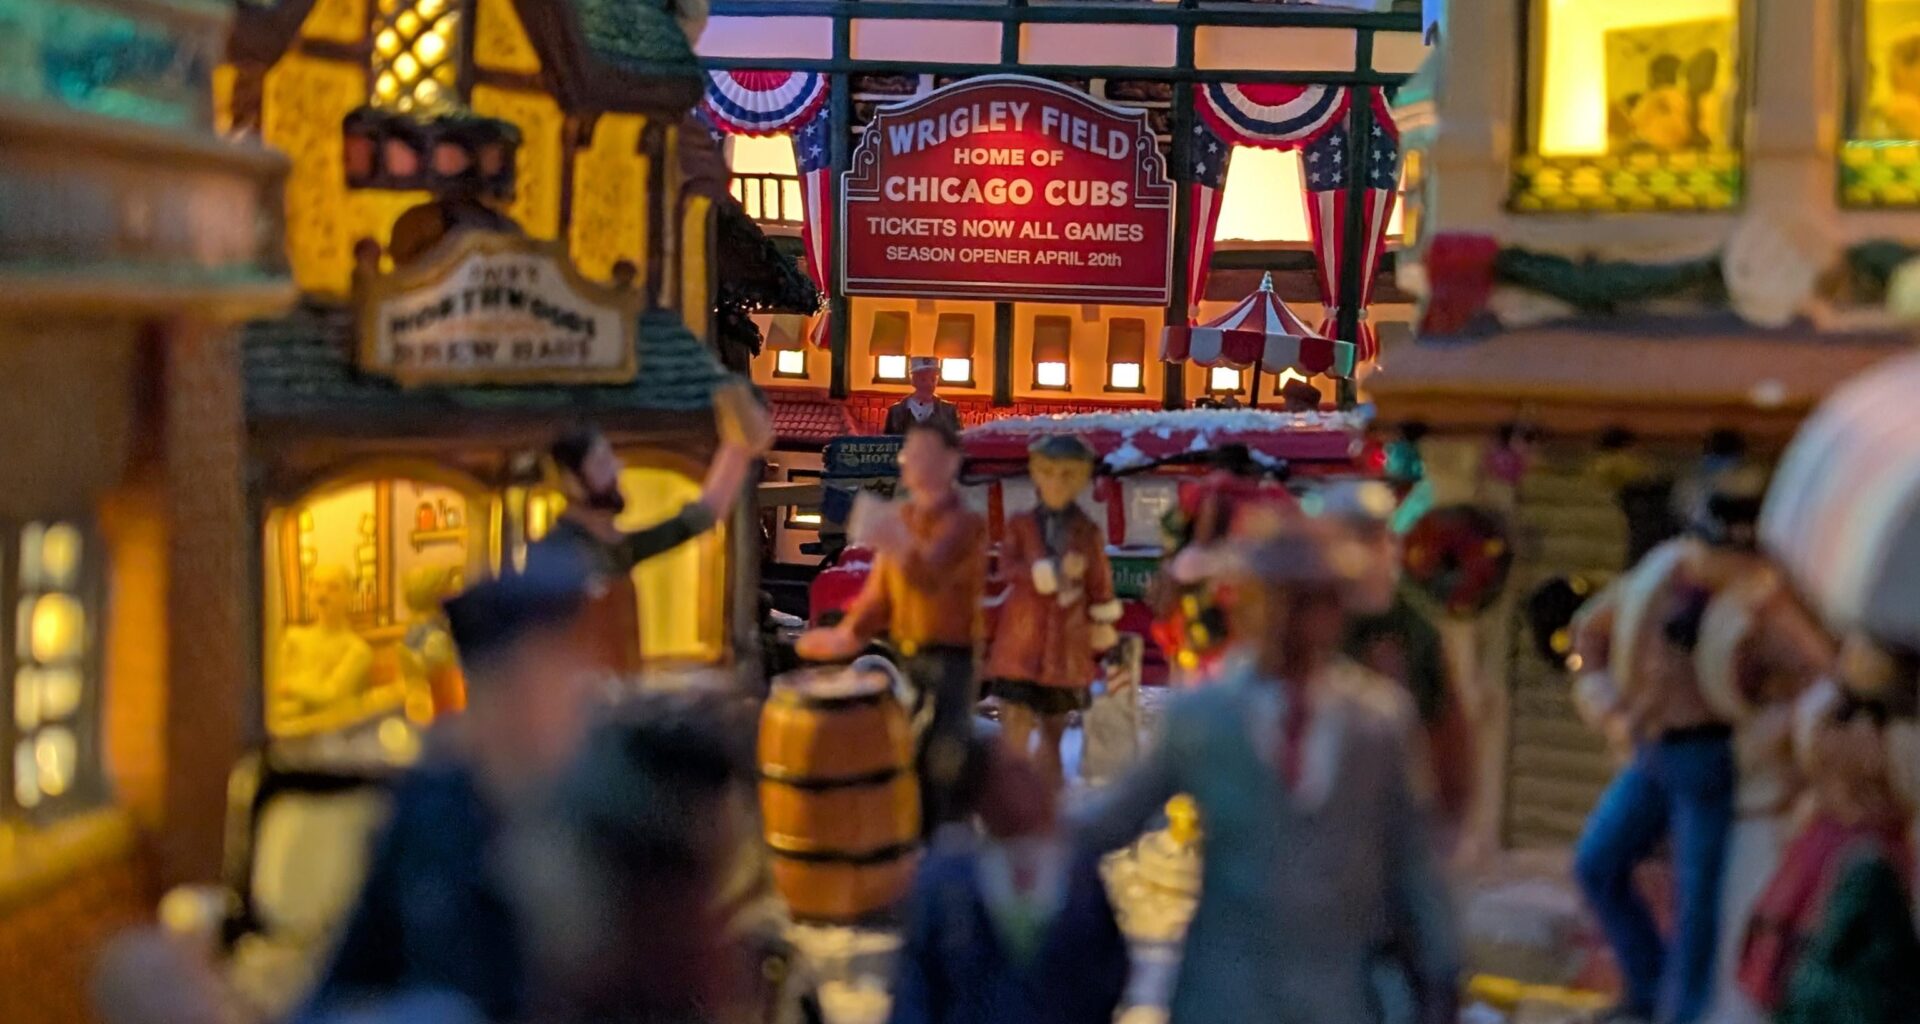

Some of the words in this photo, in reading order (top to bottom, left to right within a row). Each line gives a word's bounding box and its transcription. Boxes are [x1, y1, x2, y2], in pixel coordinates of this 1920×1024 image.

[888, 101, 1029, 156] WRIGLEY
[1041, 105, 1130, 160] FIELD
[953, 148, 1024, 166] HOME
[1030, 149, 1064, 167] OF
[885, 176, 1033, 206] CHICAGO
[1044, 179, 1128, 208] CUBS
[867, 216, 956, 237] TICKETS
[962, 219, 1015, 239] NOW
[1019, 220, 1059, 240] ALL
[1064, 222, 1144, 242] GAMES
[886, 246, 955, 263] SEASON
[959, 248, 1030, 265] OPENER
[1034, 250, 1084, 266] APRIL
[1088, 251, 1121, 268] 20th
[860, 454, 890, 464] HOT
